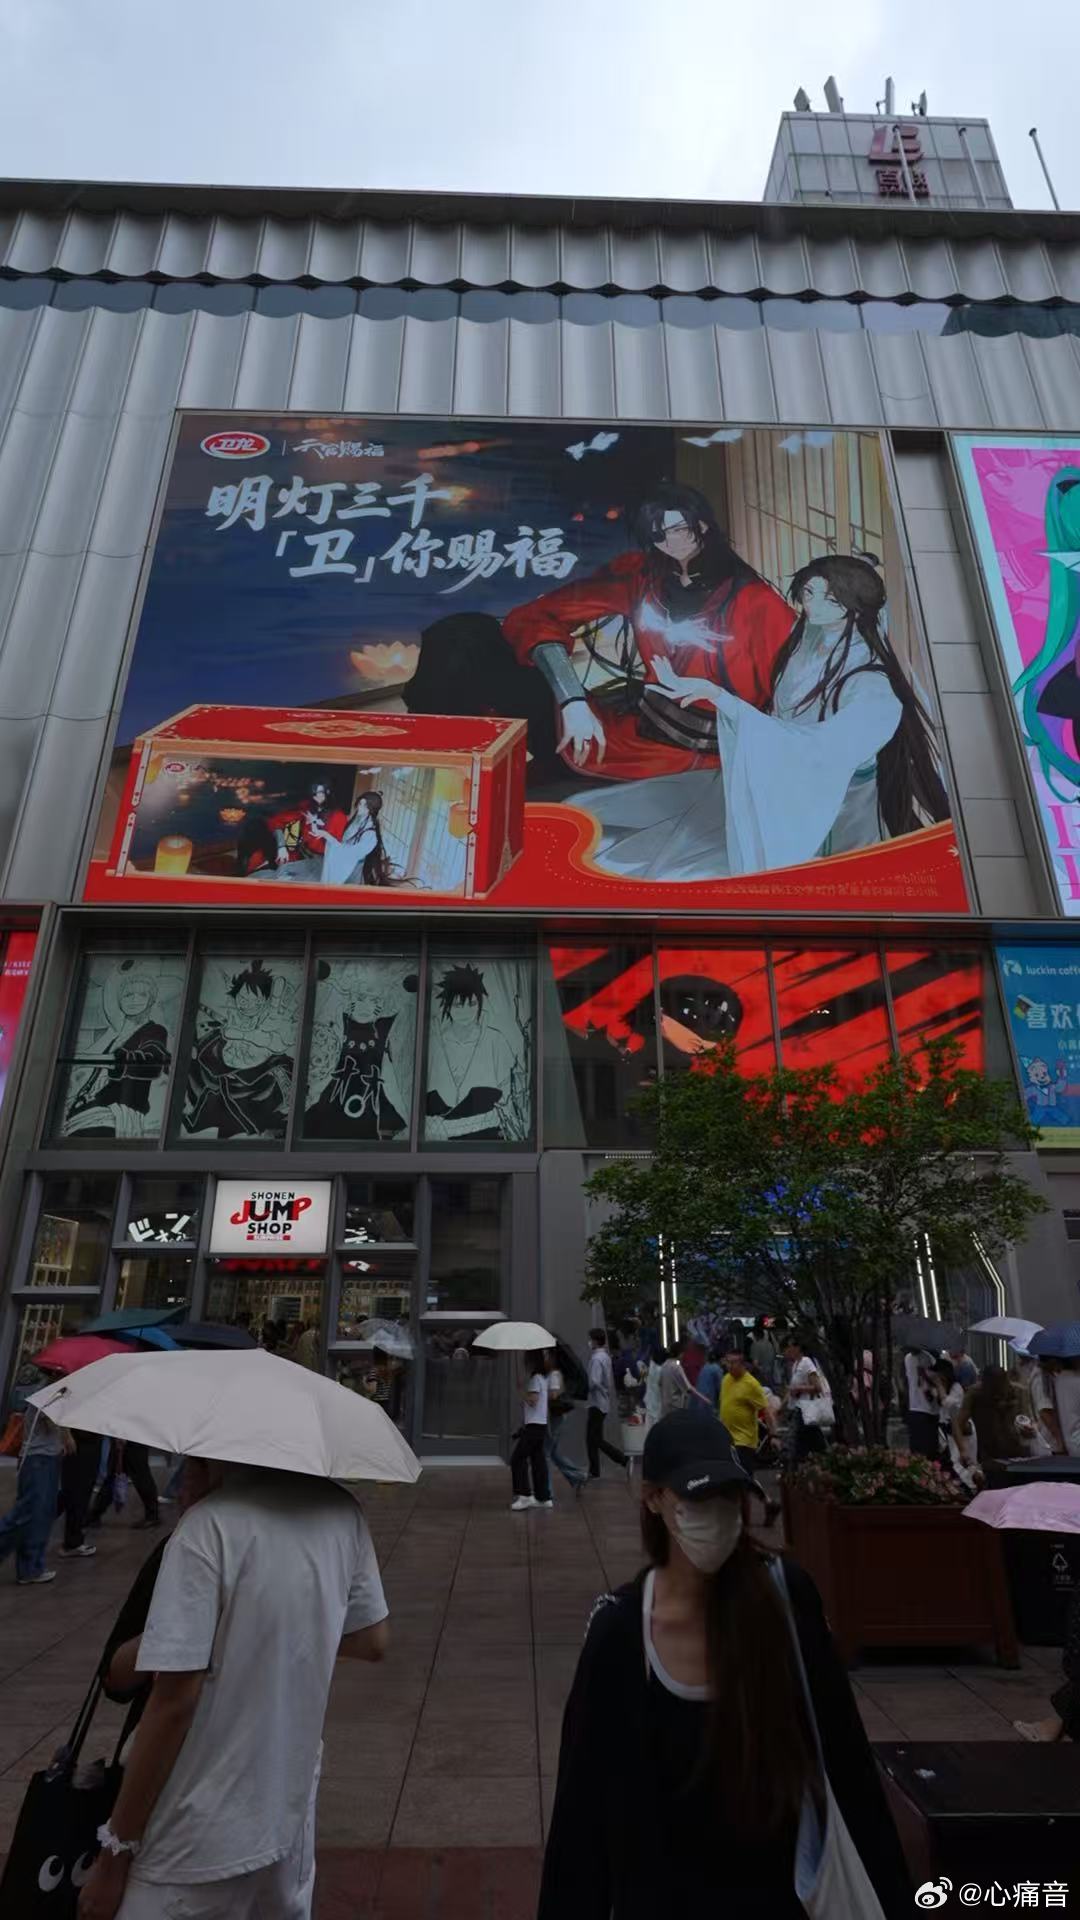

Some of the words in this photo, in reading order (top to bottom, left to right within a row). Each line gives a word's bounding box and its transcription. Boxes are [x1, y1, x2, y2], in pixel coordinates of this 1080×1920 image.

[204, 472, 452, 531] 明灯三千
[1025, 964, 1057, 976] luckin
[1027, 1003, 1080, 1029] 喜欢
[251, 1191, 295, 1200] SHONEN
[230, 1197, 312, 1224] JUMP
[247, 1222, 292, 1234] SHOP
